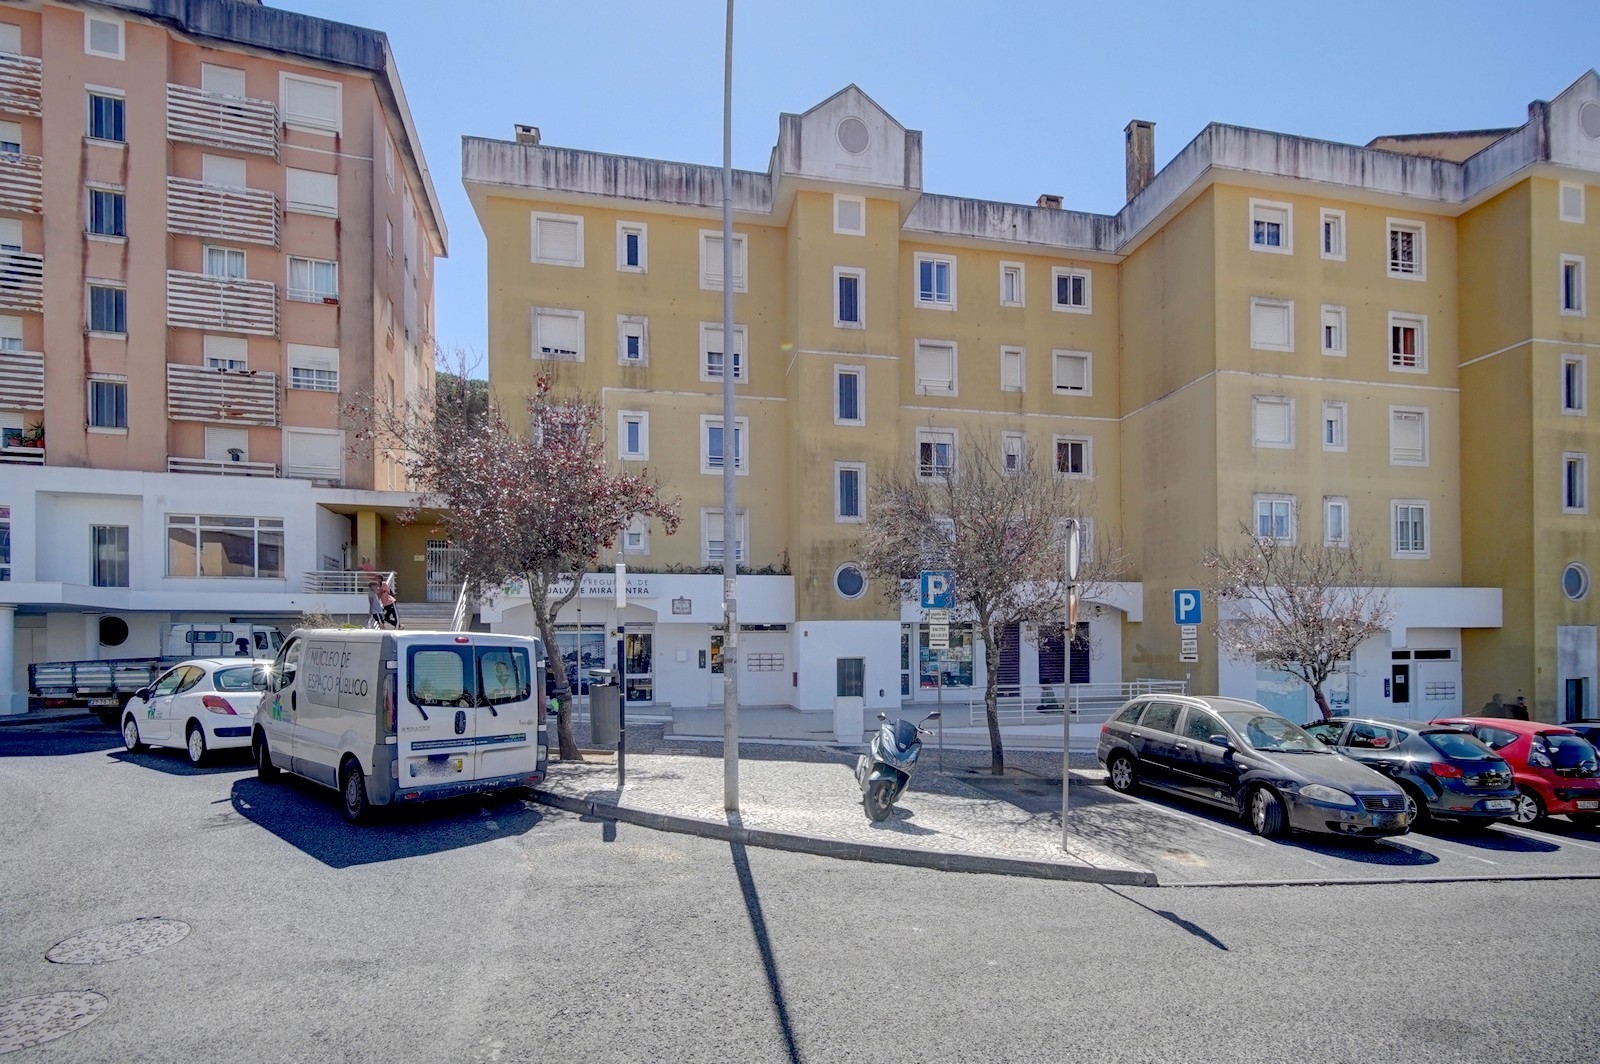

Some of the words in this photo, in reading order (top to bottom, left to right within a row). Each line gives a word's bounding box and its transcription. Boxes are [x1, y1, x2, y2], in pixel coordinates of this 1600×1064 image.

[928, 576, 948, 604] P
[1180, 593, 1196, 620] P
[340, 652, 352, 668] DE
[308, 673, 334, 695] ESPAÇO
[335, 672, 368, 696] PÚBLICO
